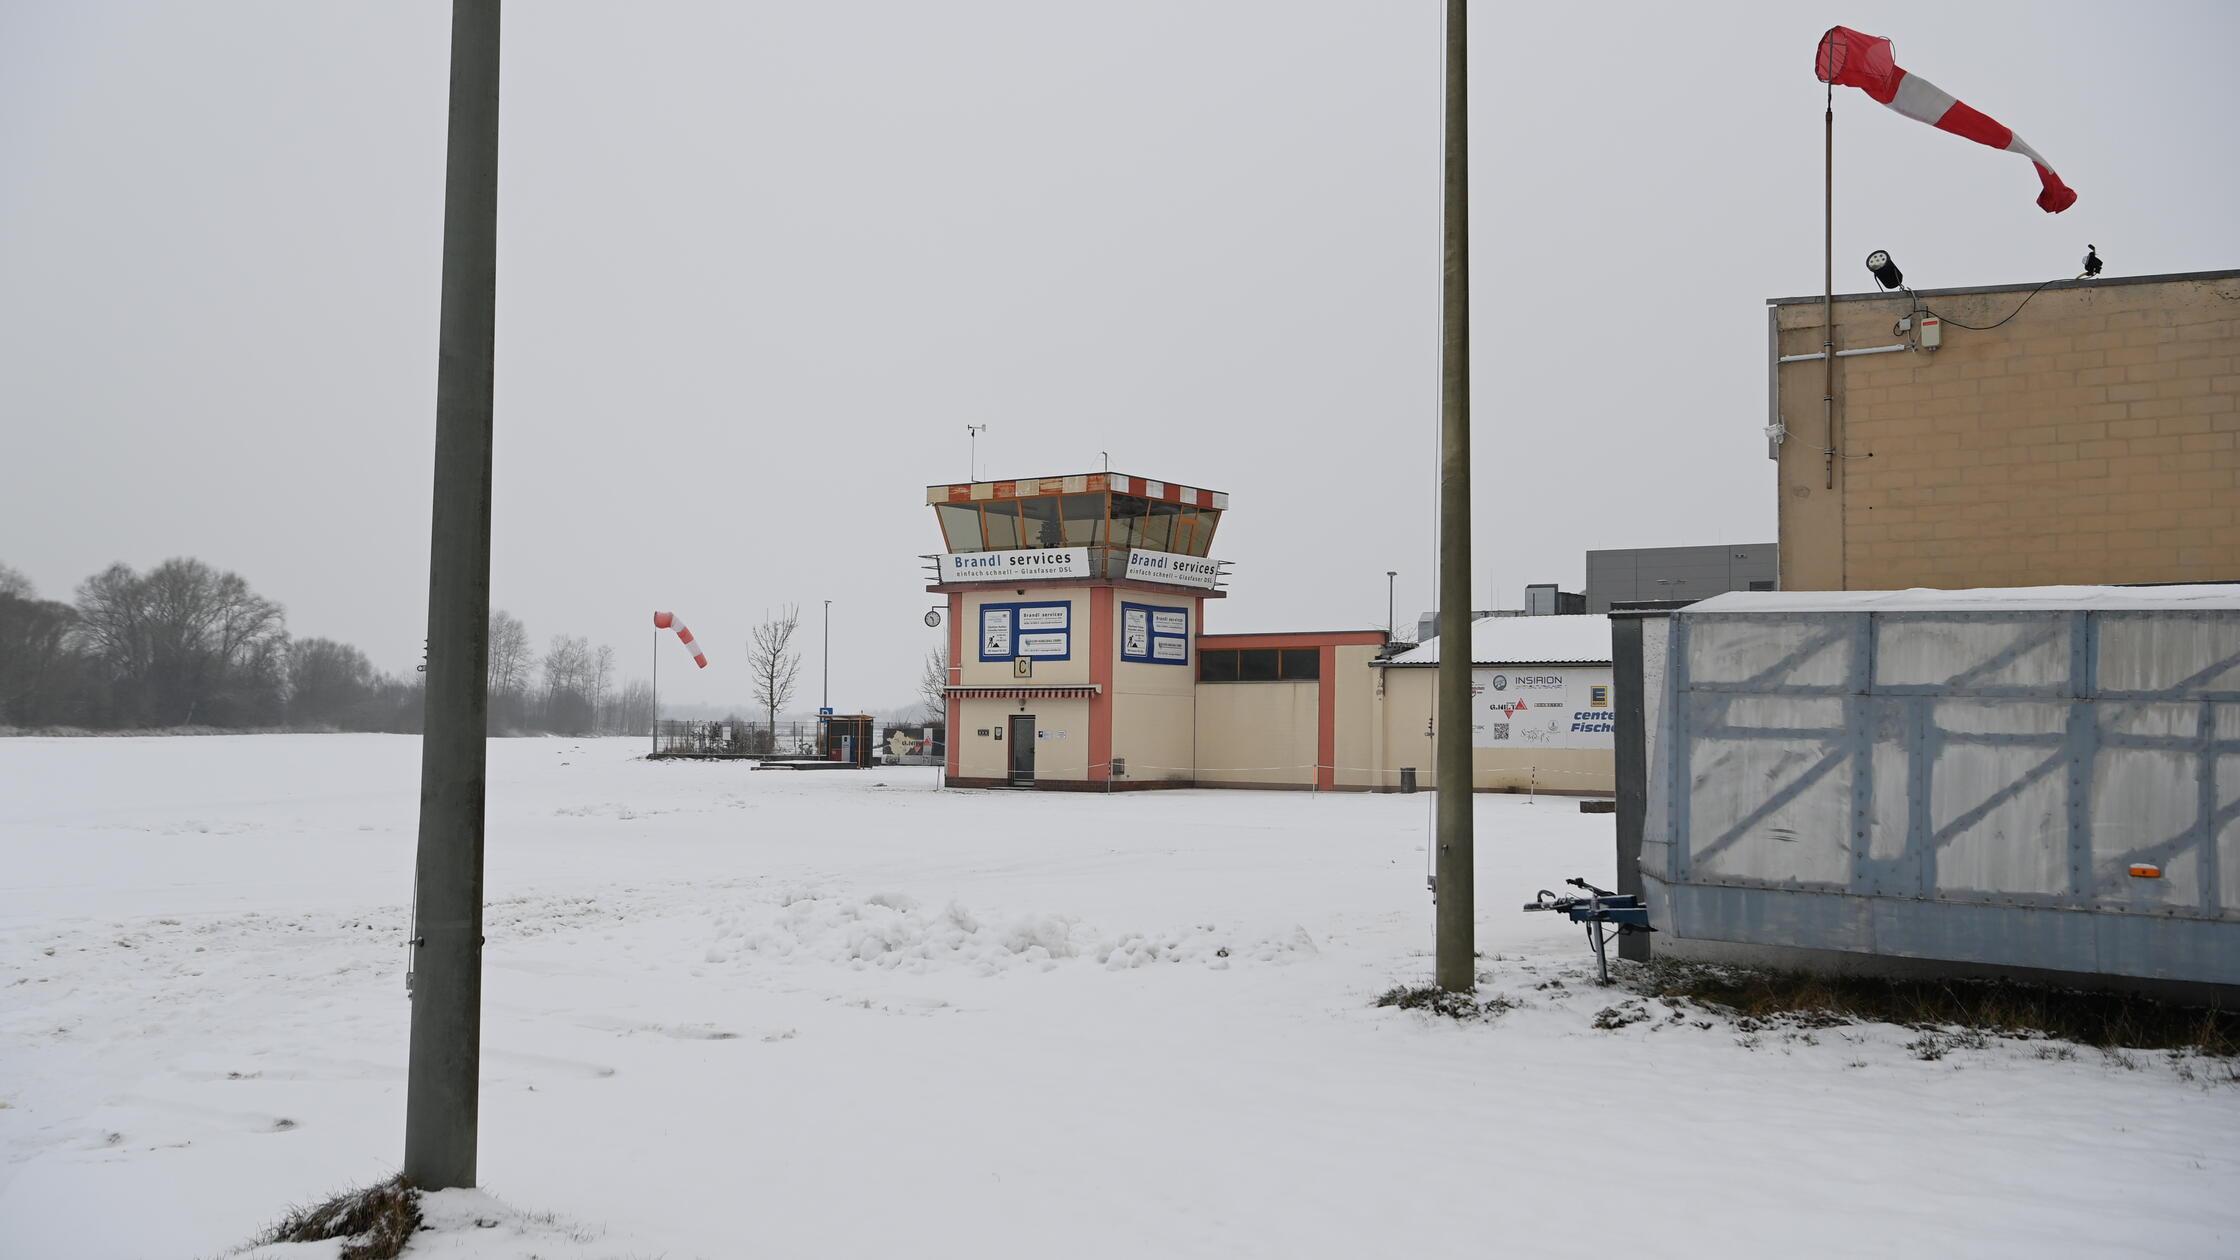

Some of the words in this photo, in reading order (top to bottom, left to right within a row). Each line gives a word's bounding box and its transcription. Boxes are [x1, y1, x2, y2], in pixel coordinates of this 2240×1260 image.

[955, 555, 1000, 568] Brandl
[1010, 552, 1071, 566] services
[1131, 553, 1168, 568] Brandl
[1173, 561, 1215, 575] services
[1021, 567, 1057, 575] Glasfaser
[1019, 660, 1026, 674] C
[1515, 676, 1563, 685] INSIRION
[1574, 711, 1615, 720] cente
